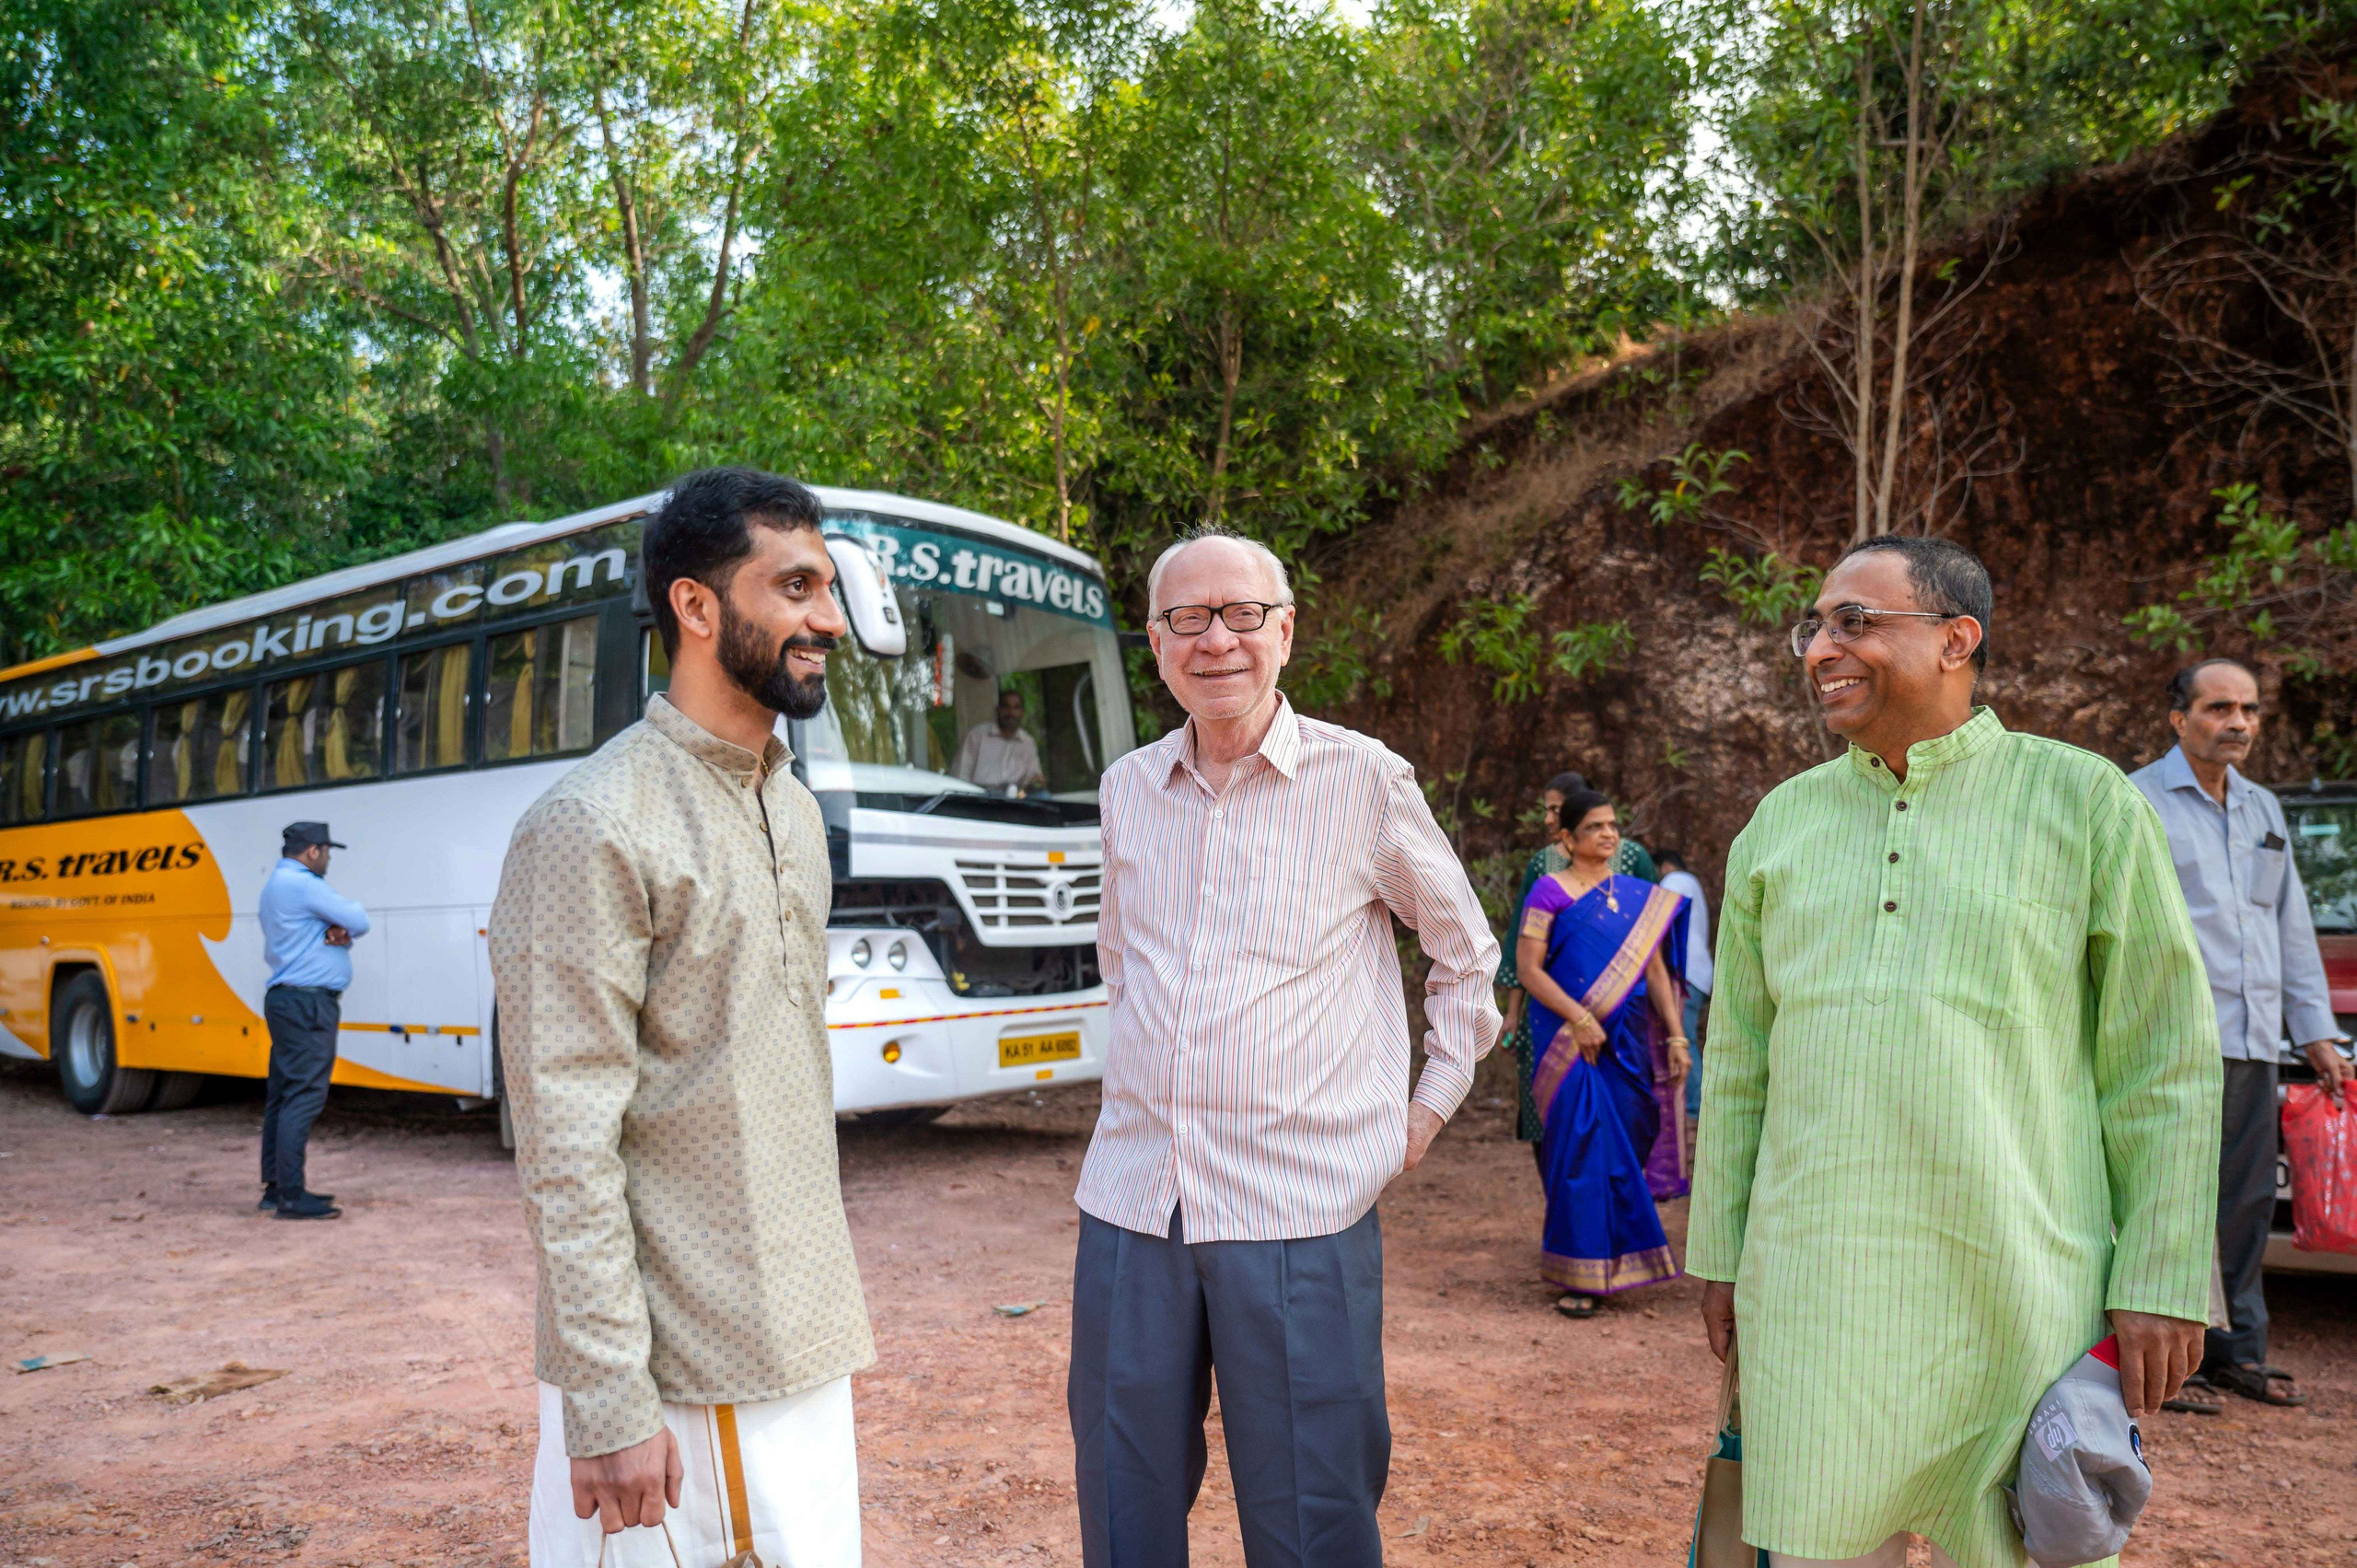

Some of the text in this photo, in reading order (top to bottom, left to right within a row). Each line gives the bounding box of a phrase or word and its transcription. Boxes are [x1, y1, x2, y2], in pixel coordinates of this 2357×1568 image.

[57, 842, 204, 879] travels
[122, 892, 156, 905] INDIA
[1005, 1044, 1020, 1058] KA
[1022, 1042, 1034, 1057] 51
[1039, 1040, 1054, 1053] AA
[2027, 1400, 2061, 1435] invent
[2047, 1421, 2065, 1449] hp
